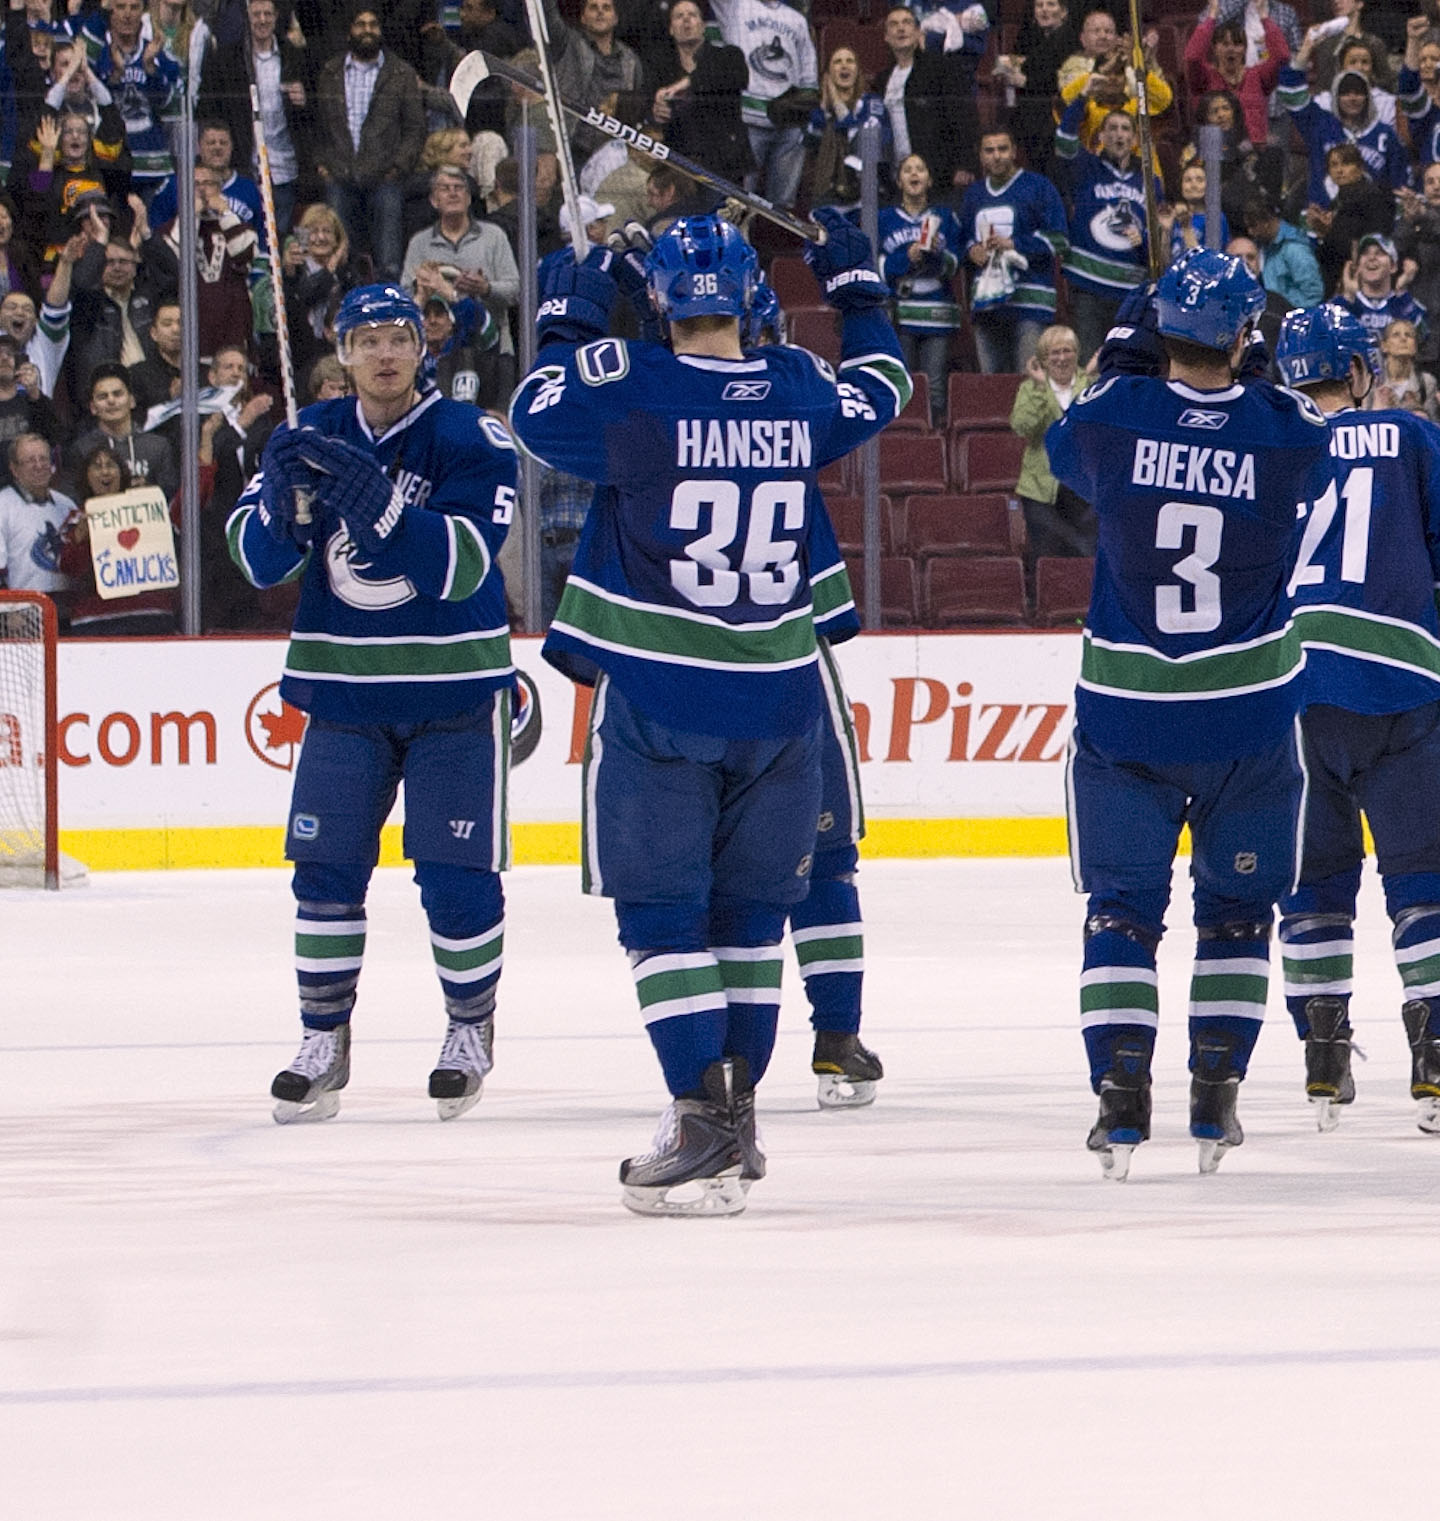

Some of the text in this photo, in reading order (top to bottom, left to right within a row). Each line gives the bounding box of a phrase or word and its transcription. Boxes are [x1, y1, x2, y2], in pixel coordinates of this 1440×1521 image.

[692, 273, 718, 295] 36
[1185, 283, 1200, 306] 3
[1291, 356, 1310, 379] 21
[676, 419, 813, 468] HANSEN
[1328, 422, 1400, 460] OND
[1131, 438, 1256, 501] BIEKSA
[491, 485, 516, 525] 5
[670, 480, 807, 608] 36
[1286, 466, 1374, 599] 21
[1155, 501, 1225, 635] 3
